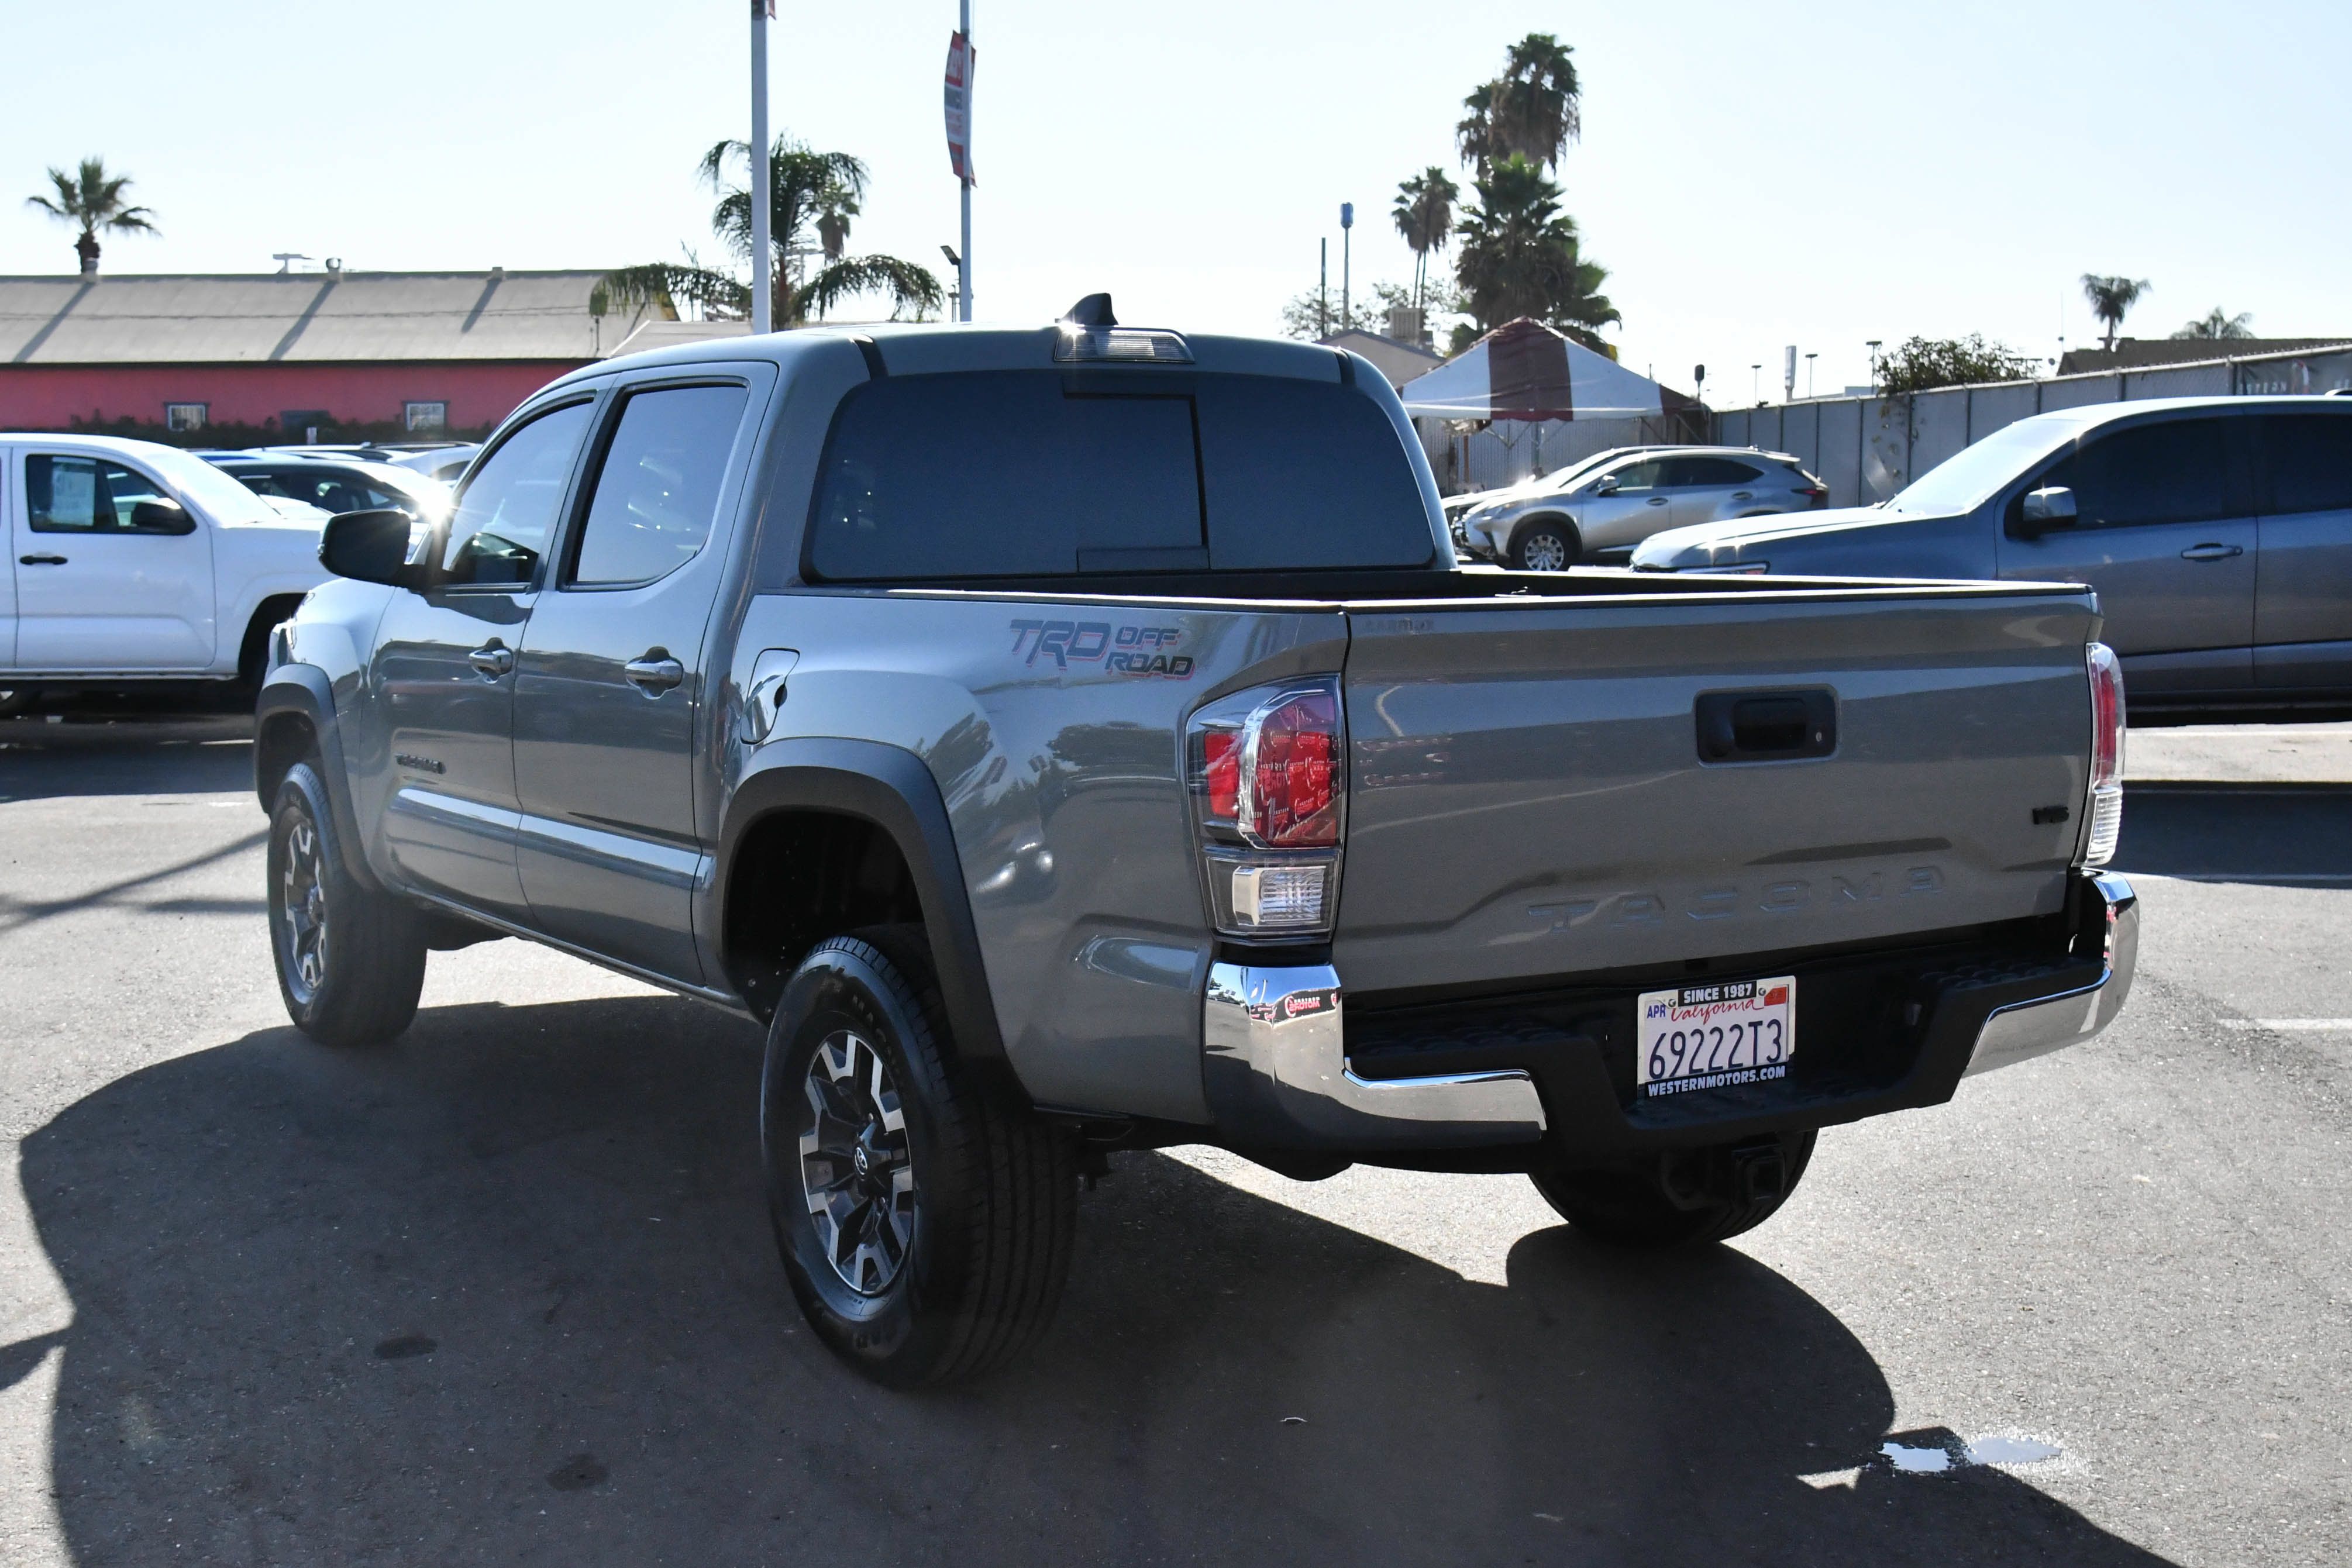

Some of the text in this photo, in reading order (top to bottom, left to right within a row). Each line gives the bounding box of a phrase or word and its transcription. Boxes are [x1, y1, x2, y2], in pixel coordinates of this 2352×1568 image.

[1010, 619, 1180, 671] TRD OFF
[1105, 652, 1195, 680] ROAD
[1528, 866, 1944, 935] TACOMA
[1683, 984, 1719, 1004] SINCE
[1724, 983, 1752, 995] 1987
[1647, 1004, 1666, 1019] APR
[1671, 998, 1764, 1025] California
[1649, 1019, 1782, 1080] 69222T3
[1648, 1066, 1786, 1097] WESTERNMOTORS.COM
